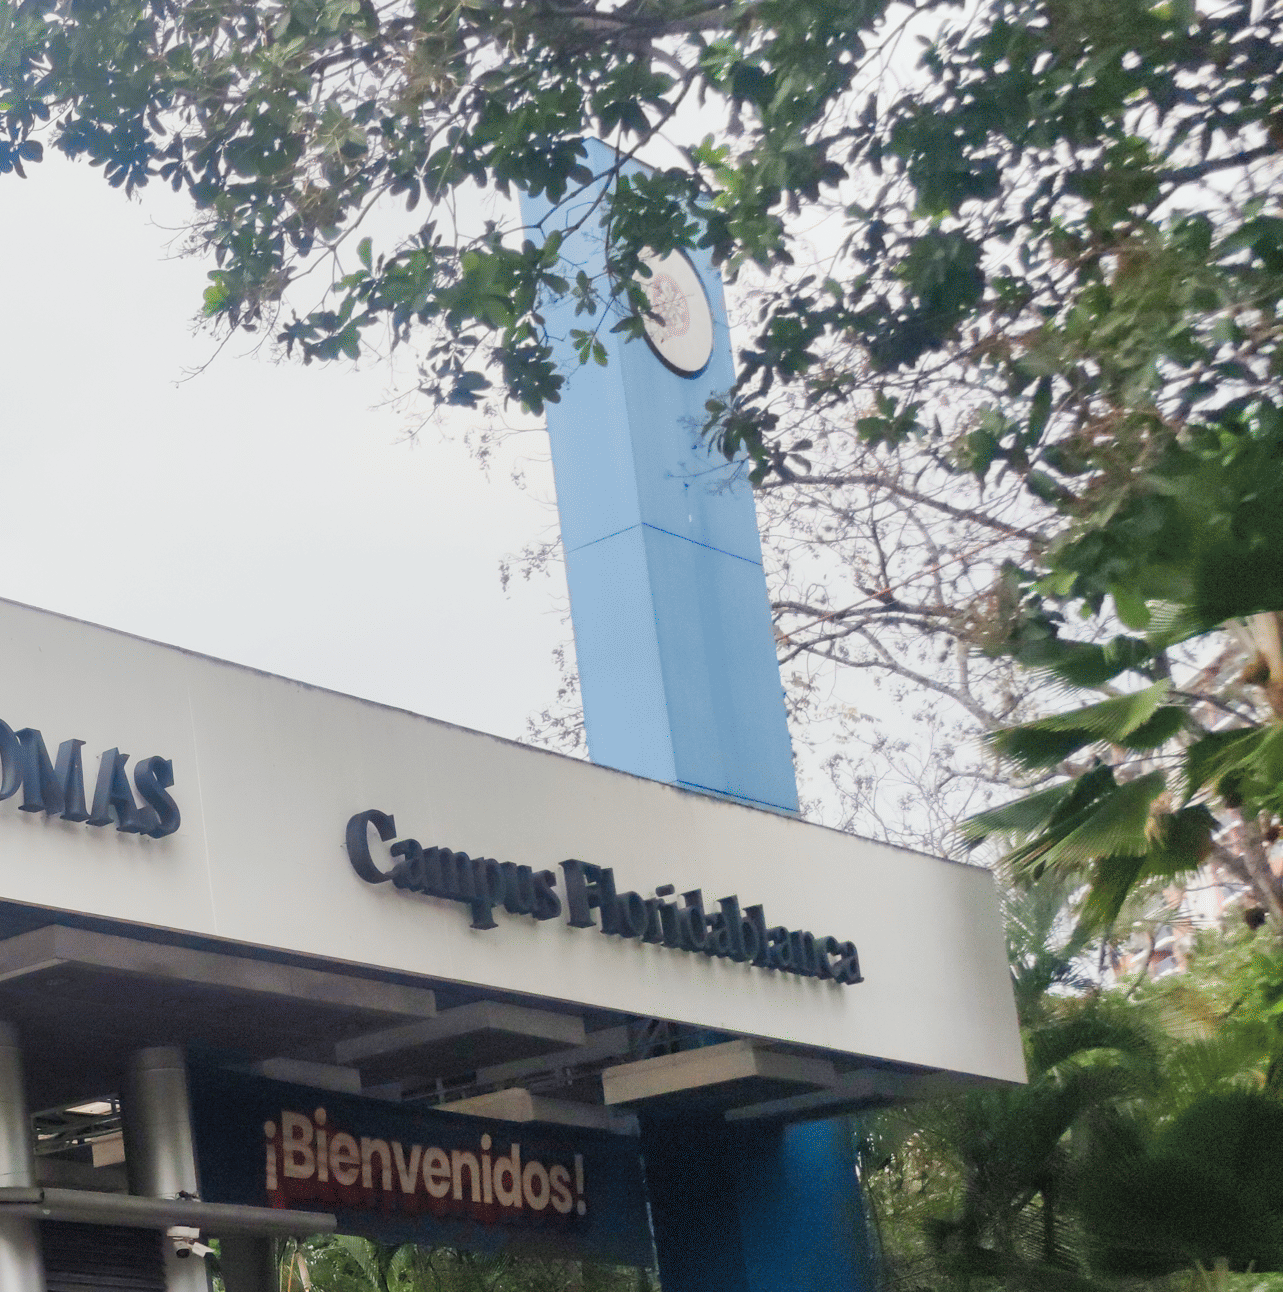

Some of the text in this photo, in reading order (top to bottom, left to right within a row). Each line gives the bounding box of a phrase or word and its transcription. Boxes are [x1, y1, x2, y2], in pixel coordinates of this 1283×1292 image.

[345, 808, 865, 986] Campus Floridablanca
[263, 1106, 588, 1216] ¡Bienvenidos!
